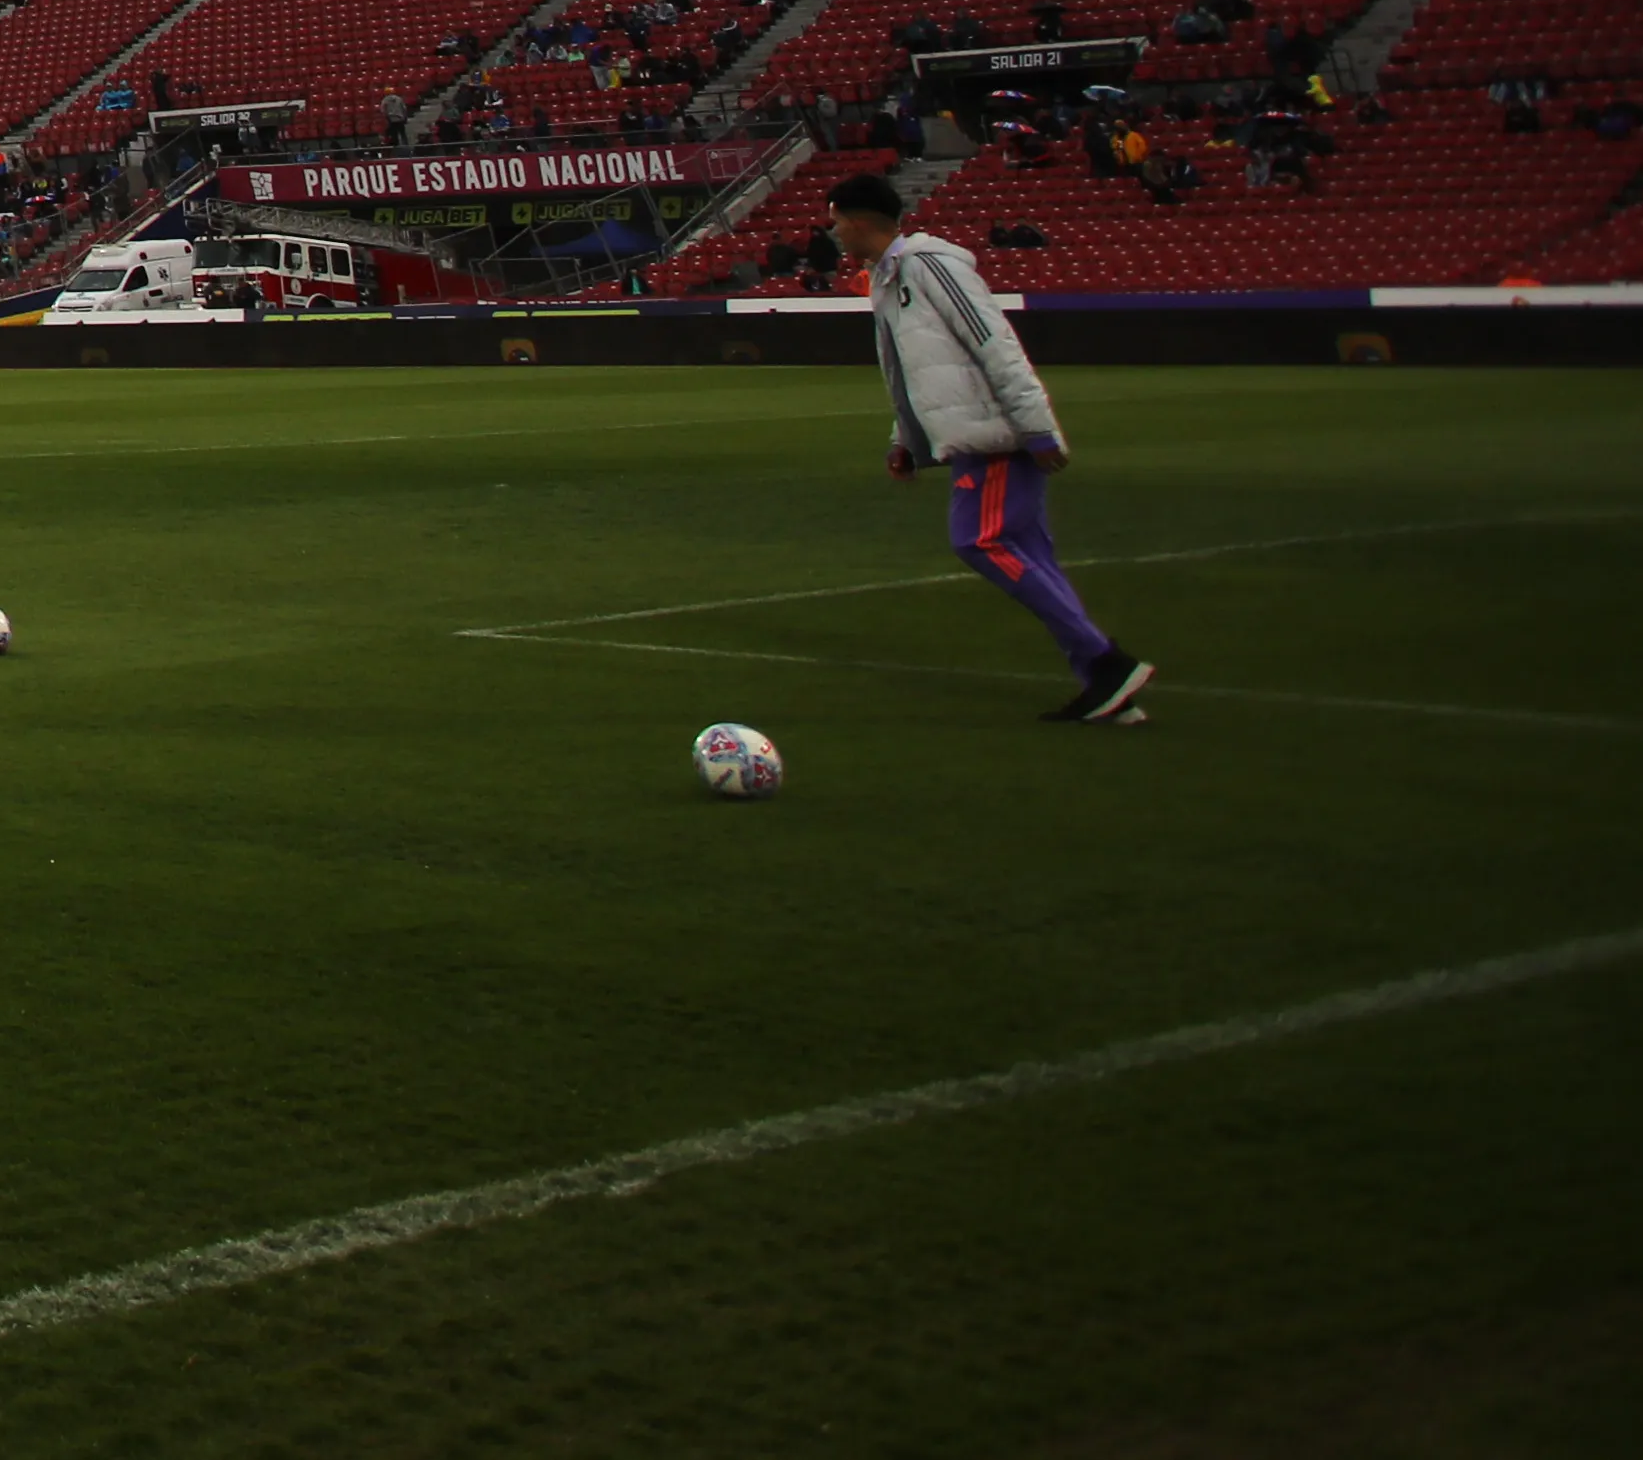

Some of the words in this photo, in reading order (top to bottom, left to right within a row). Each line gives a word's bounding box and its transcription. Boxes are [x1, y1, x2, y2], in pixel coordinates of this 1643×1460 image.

[991, 53, 1043, 69] SALIDA
[1047, 51, 1061, 66] 21
[201, 113, 236, 126] SALIDA
[303, 163, 403, 199] PARQUE
[413, 157, 528, 192] ESTADIO
[539, 149, 685, 186] NACIONAL
[400, 209, 445, 225] JUGA
[448, 207, 485, 223] BET
